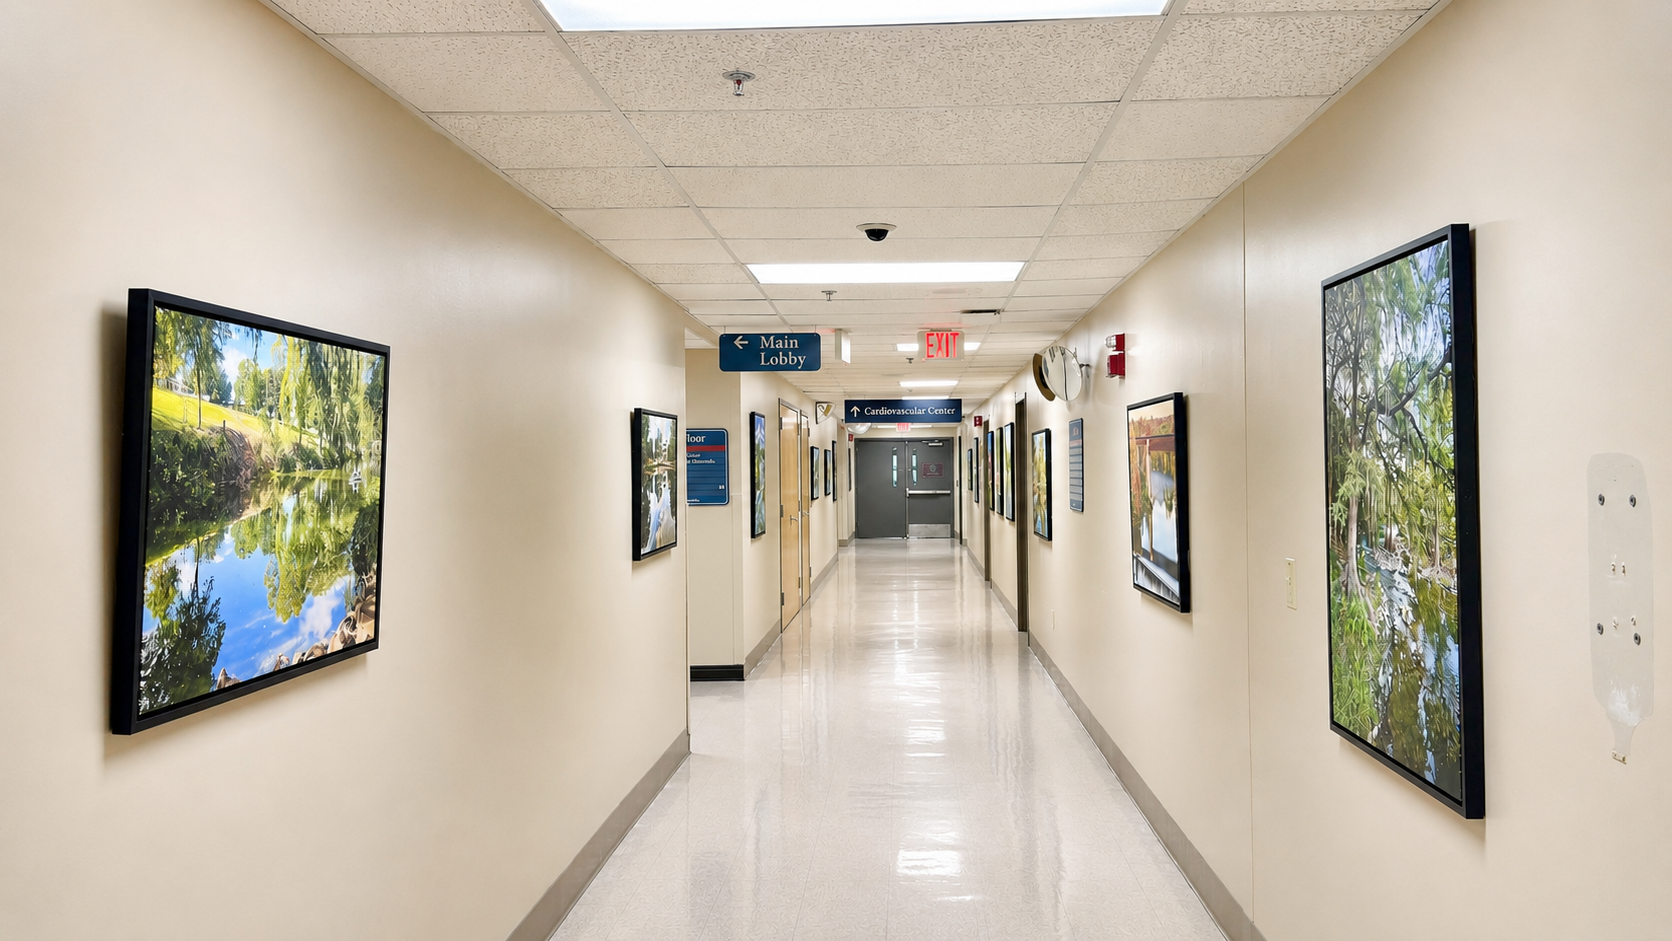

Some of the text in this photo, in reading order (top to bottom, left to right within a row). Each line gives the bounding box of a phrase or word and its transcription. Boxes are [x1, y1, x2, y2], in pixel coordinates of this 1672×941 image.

[760, 335, 799, 349] Main
[926, 332, 960, 359] EXIT
[760, 351, 807, 370] Lobby
[864, 406, 956, 416] Cardiovascular Center
[686, 433, 706, 443] loor
